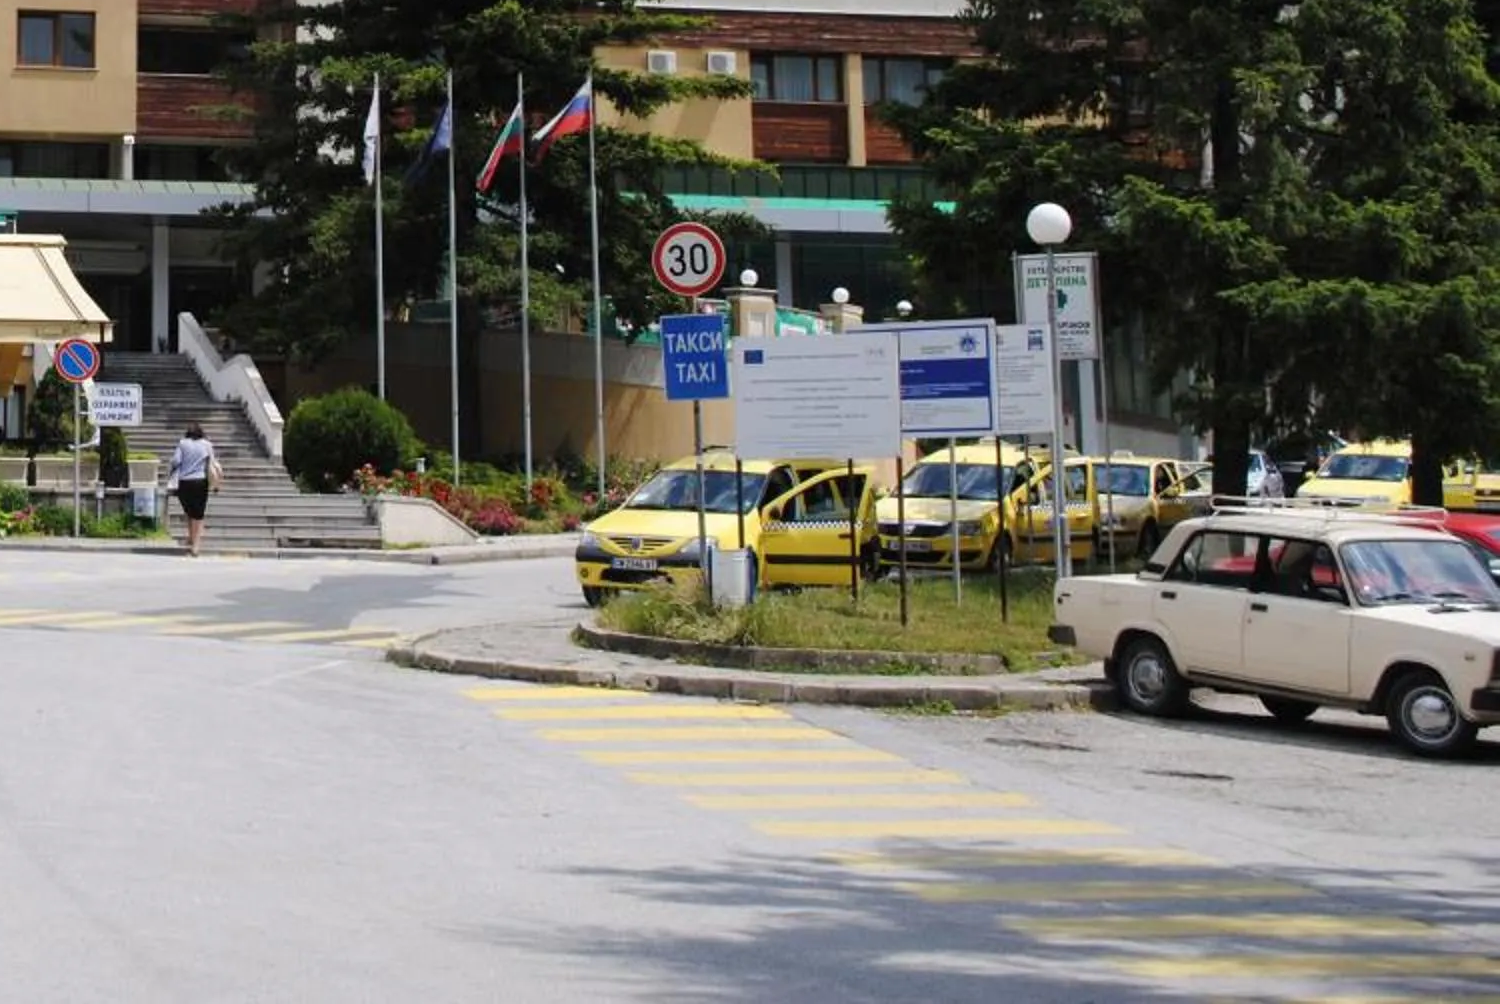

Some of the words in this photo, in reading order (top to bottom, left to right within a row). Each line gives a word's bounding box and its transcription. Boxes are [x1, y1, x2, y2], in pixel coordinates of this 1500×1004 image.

[668, 243, 709, 277] 30
[664, 331, 723, 354] ТАКСИ
[675, 361, 717, 384] TAXI
